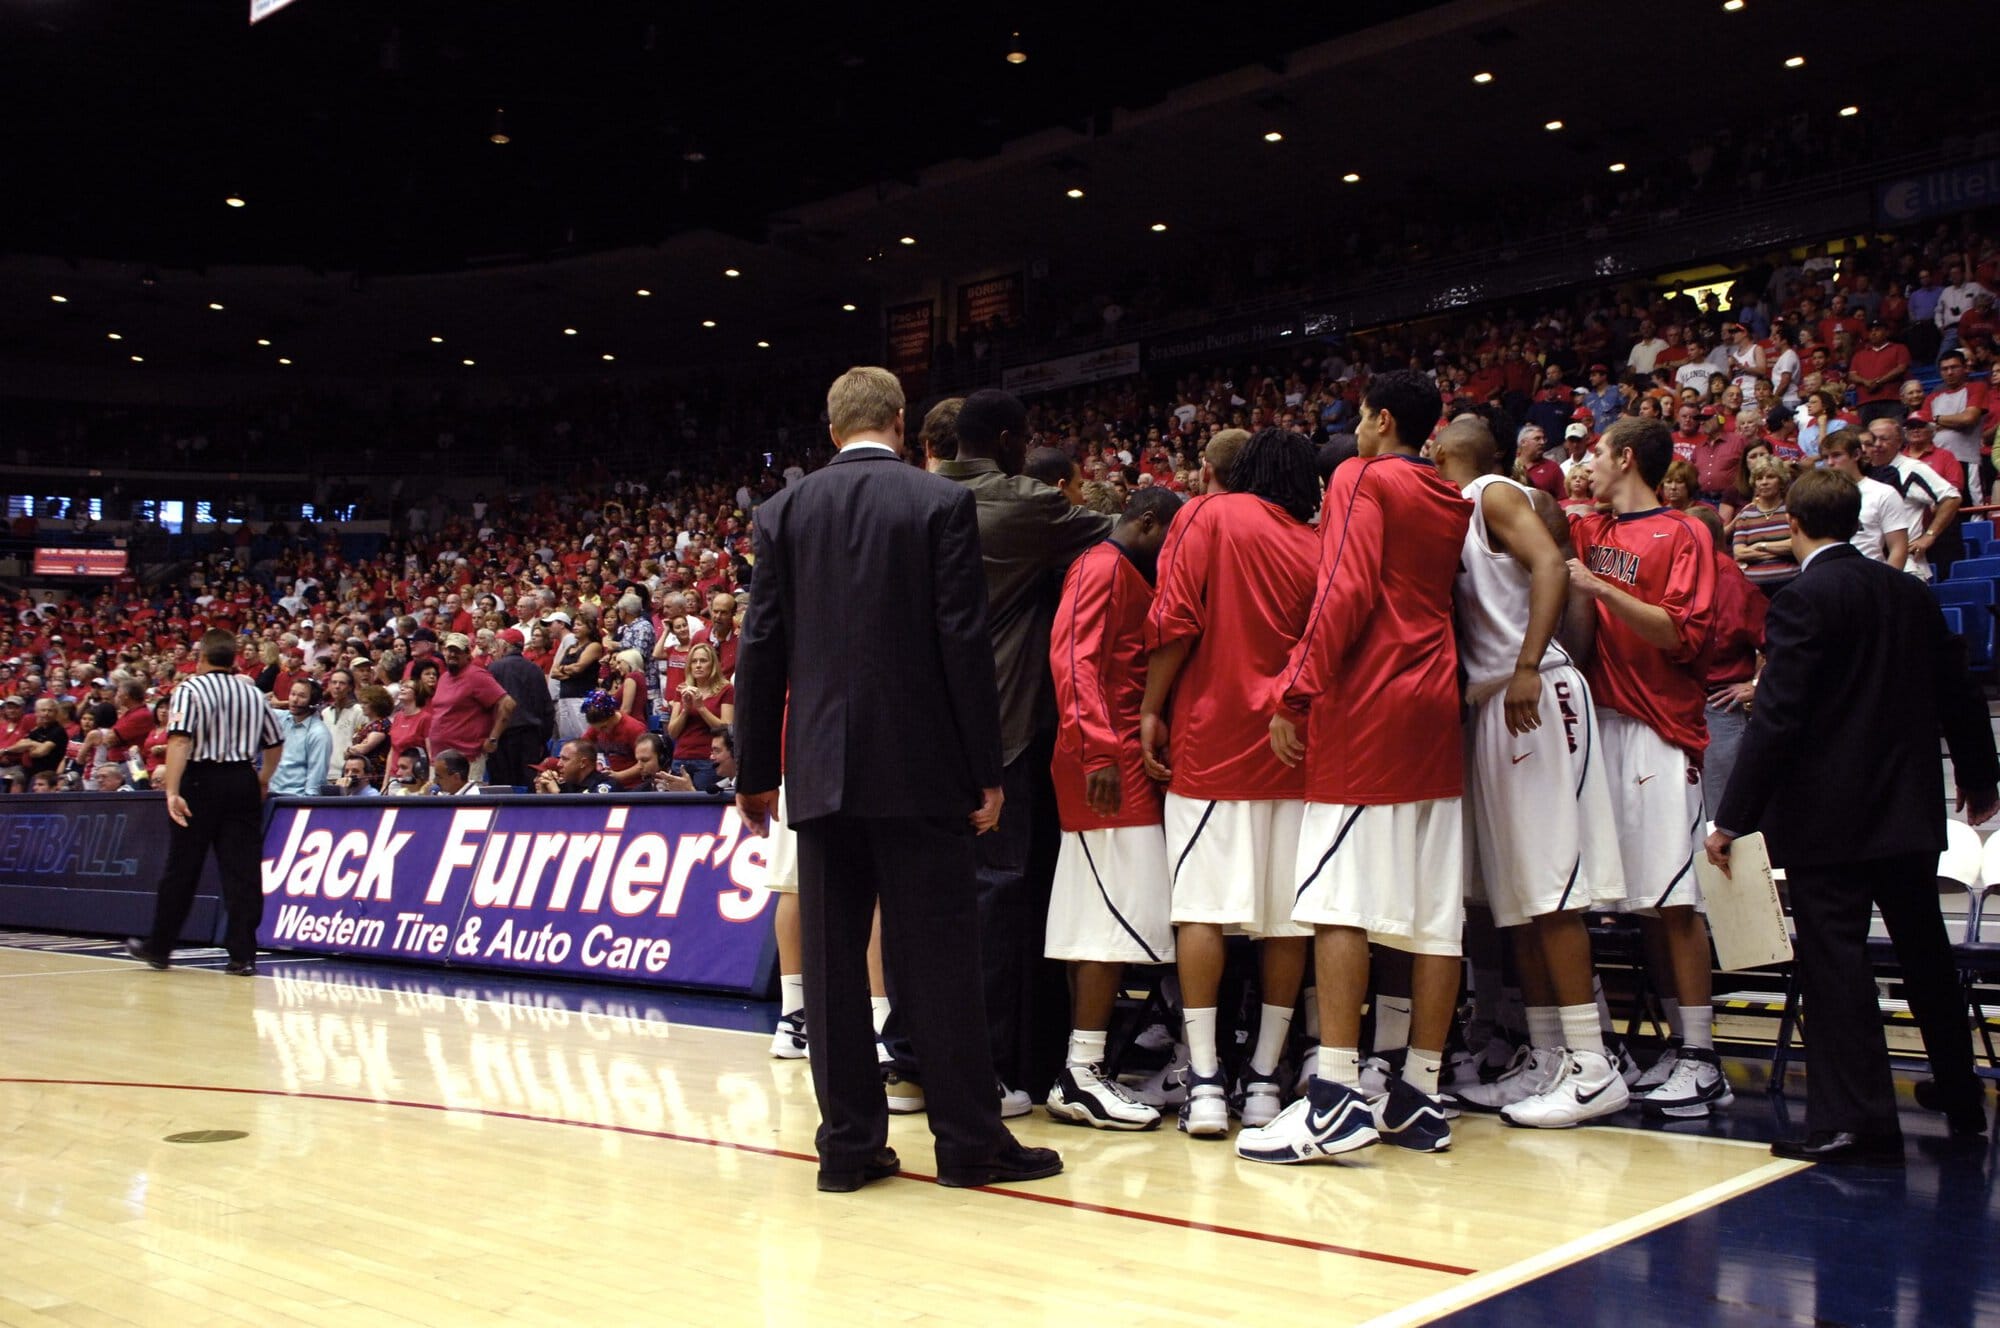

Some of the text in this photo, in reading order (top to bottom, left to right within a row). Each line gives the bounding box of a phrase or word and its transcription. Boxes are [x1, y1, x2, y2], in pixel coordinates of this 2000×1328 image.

[1585, 544, 1640, 586] RIZONA
[261, 805, 773, 923] Jack Furrier's
[272, 903, 386, 949] Western
[391, 911, 449, 954] Tire
[454, 915, 482, 957] &
[484, 919, 572, 965] Auto
[580, 923, 671, 973] Care
